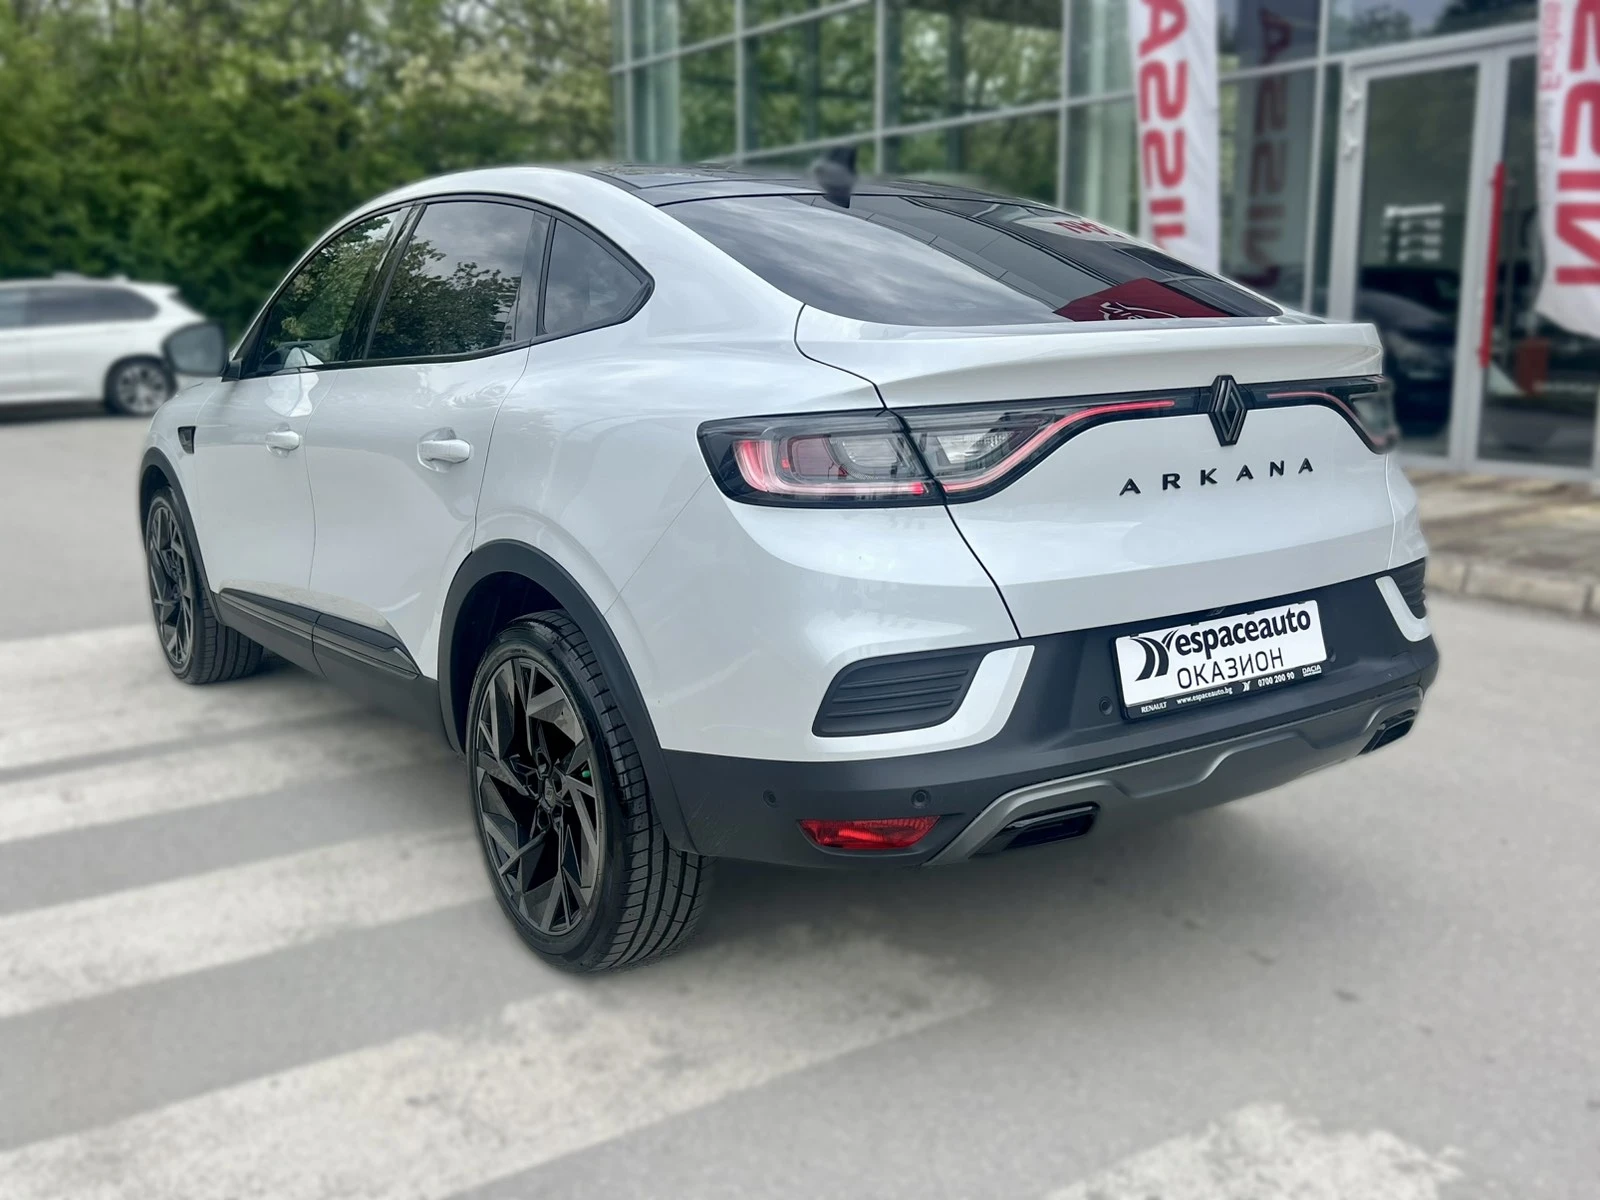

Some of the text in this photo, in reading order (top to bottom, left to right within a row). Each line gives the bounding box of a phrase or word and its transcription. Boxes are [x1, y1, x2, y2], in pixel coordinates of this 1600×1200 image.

[1119, 457, 1313, 496] ARKANA
[1175, 608, 1311, 660] espaceauto
[1140, 664, 1321, 713] RENAULT www.espaceauto.bg 0700 200 90 DACIA
[1177, 647, 1284, 689] ОКАЗИОН
